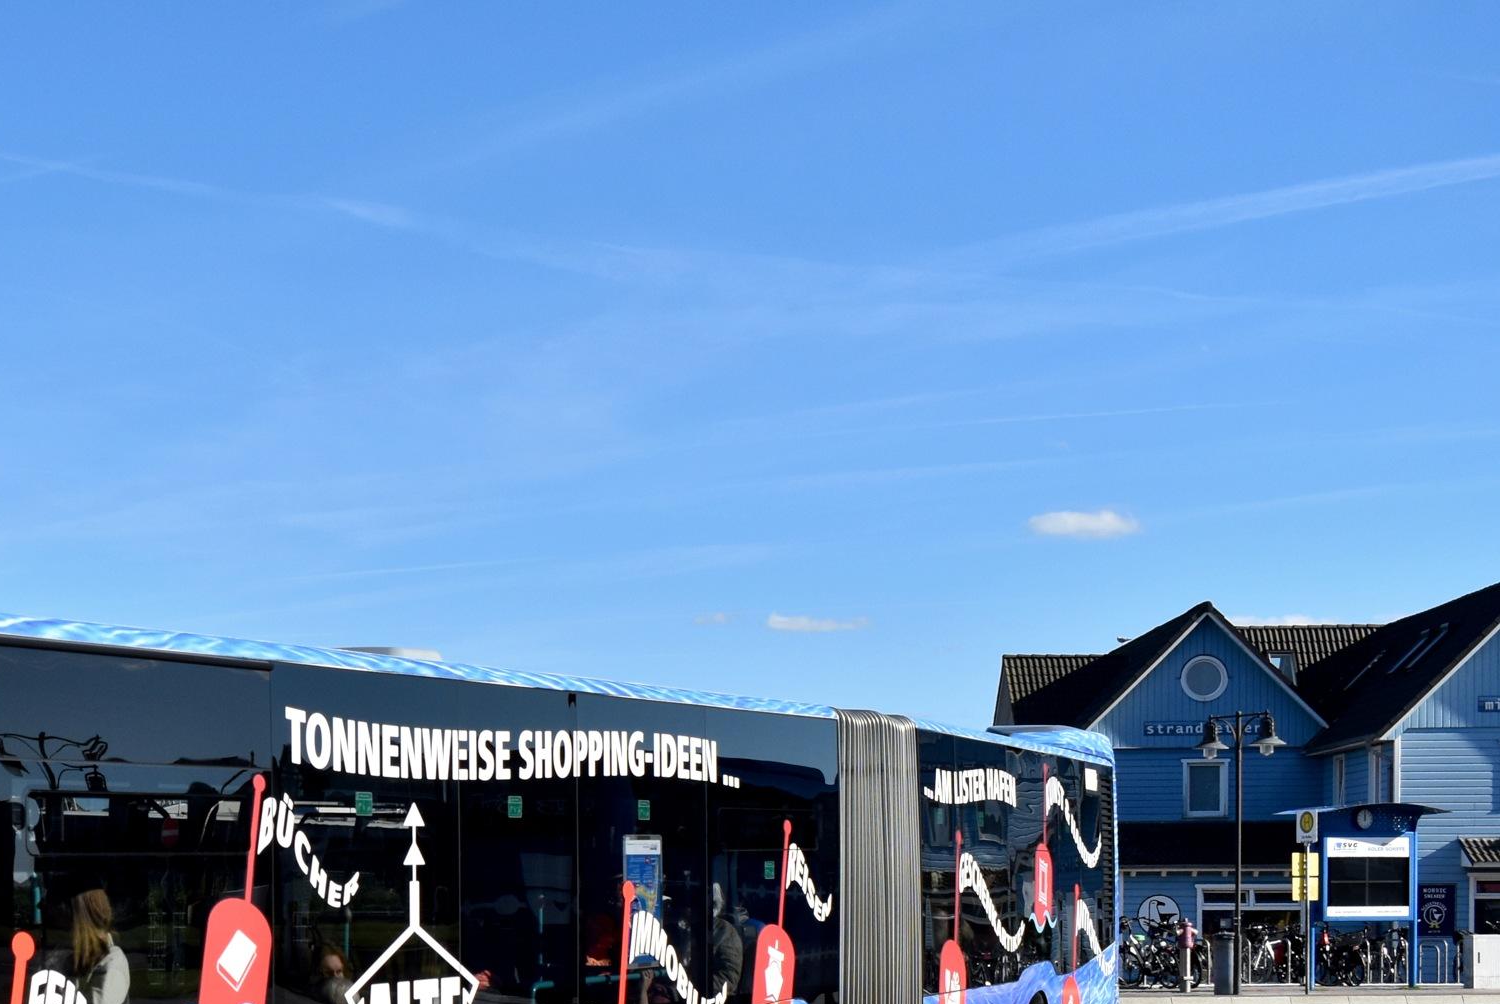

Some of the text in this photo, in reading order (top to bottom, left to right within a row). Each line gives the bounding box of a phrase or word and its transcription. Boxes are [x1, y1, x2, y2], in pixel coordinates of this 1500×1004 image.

[284, 706, 511, 781] TONNENWEISE
[519, 729, 718, 784] SHOPPING-IDEEN
[1146, 722, 1261, 734] strandeter
[954, 768, 985, 805] LISTER
[986, 768, 1017, 808] HAFEN
[257, 792, 360, 908] BÜCHER
[785, 842, 833, 923] REISEN
